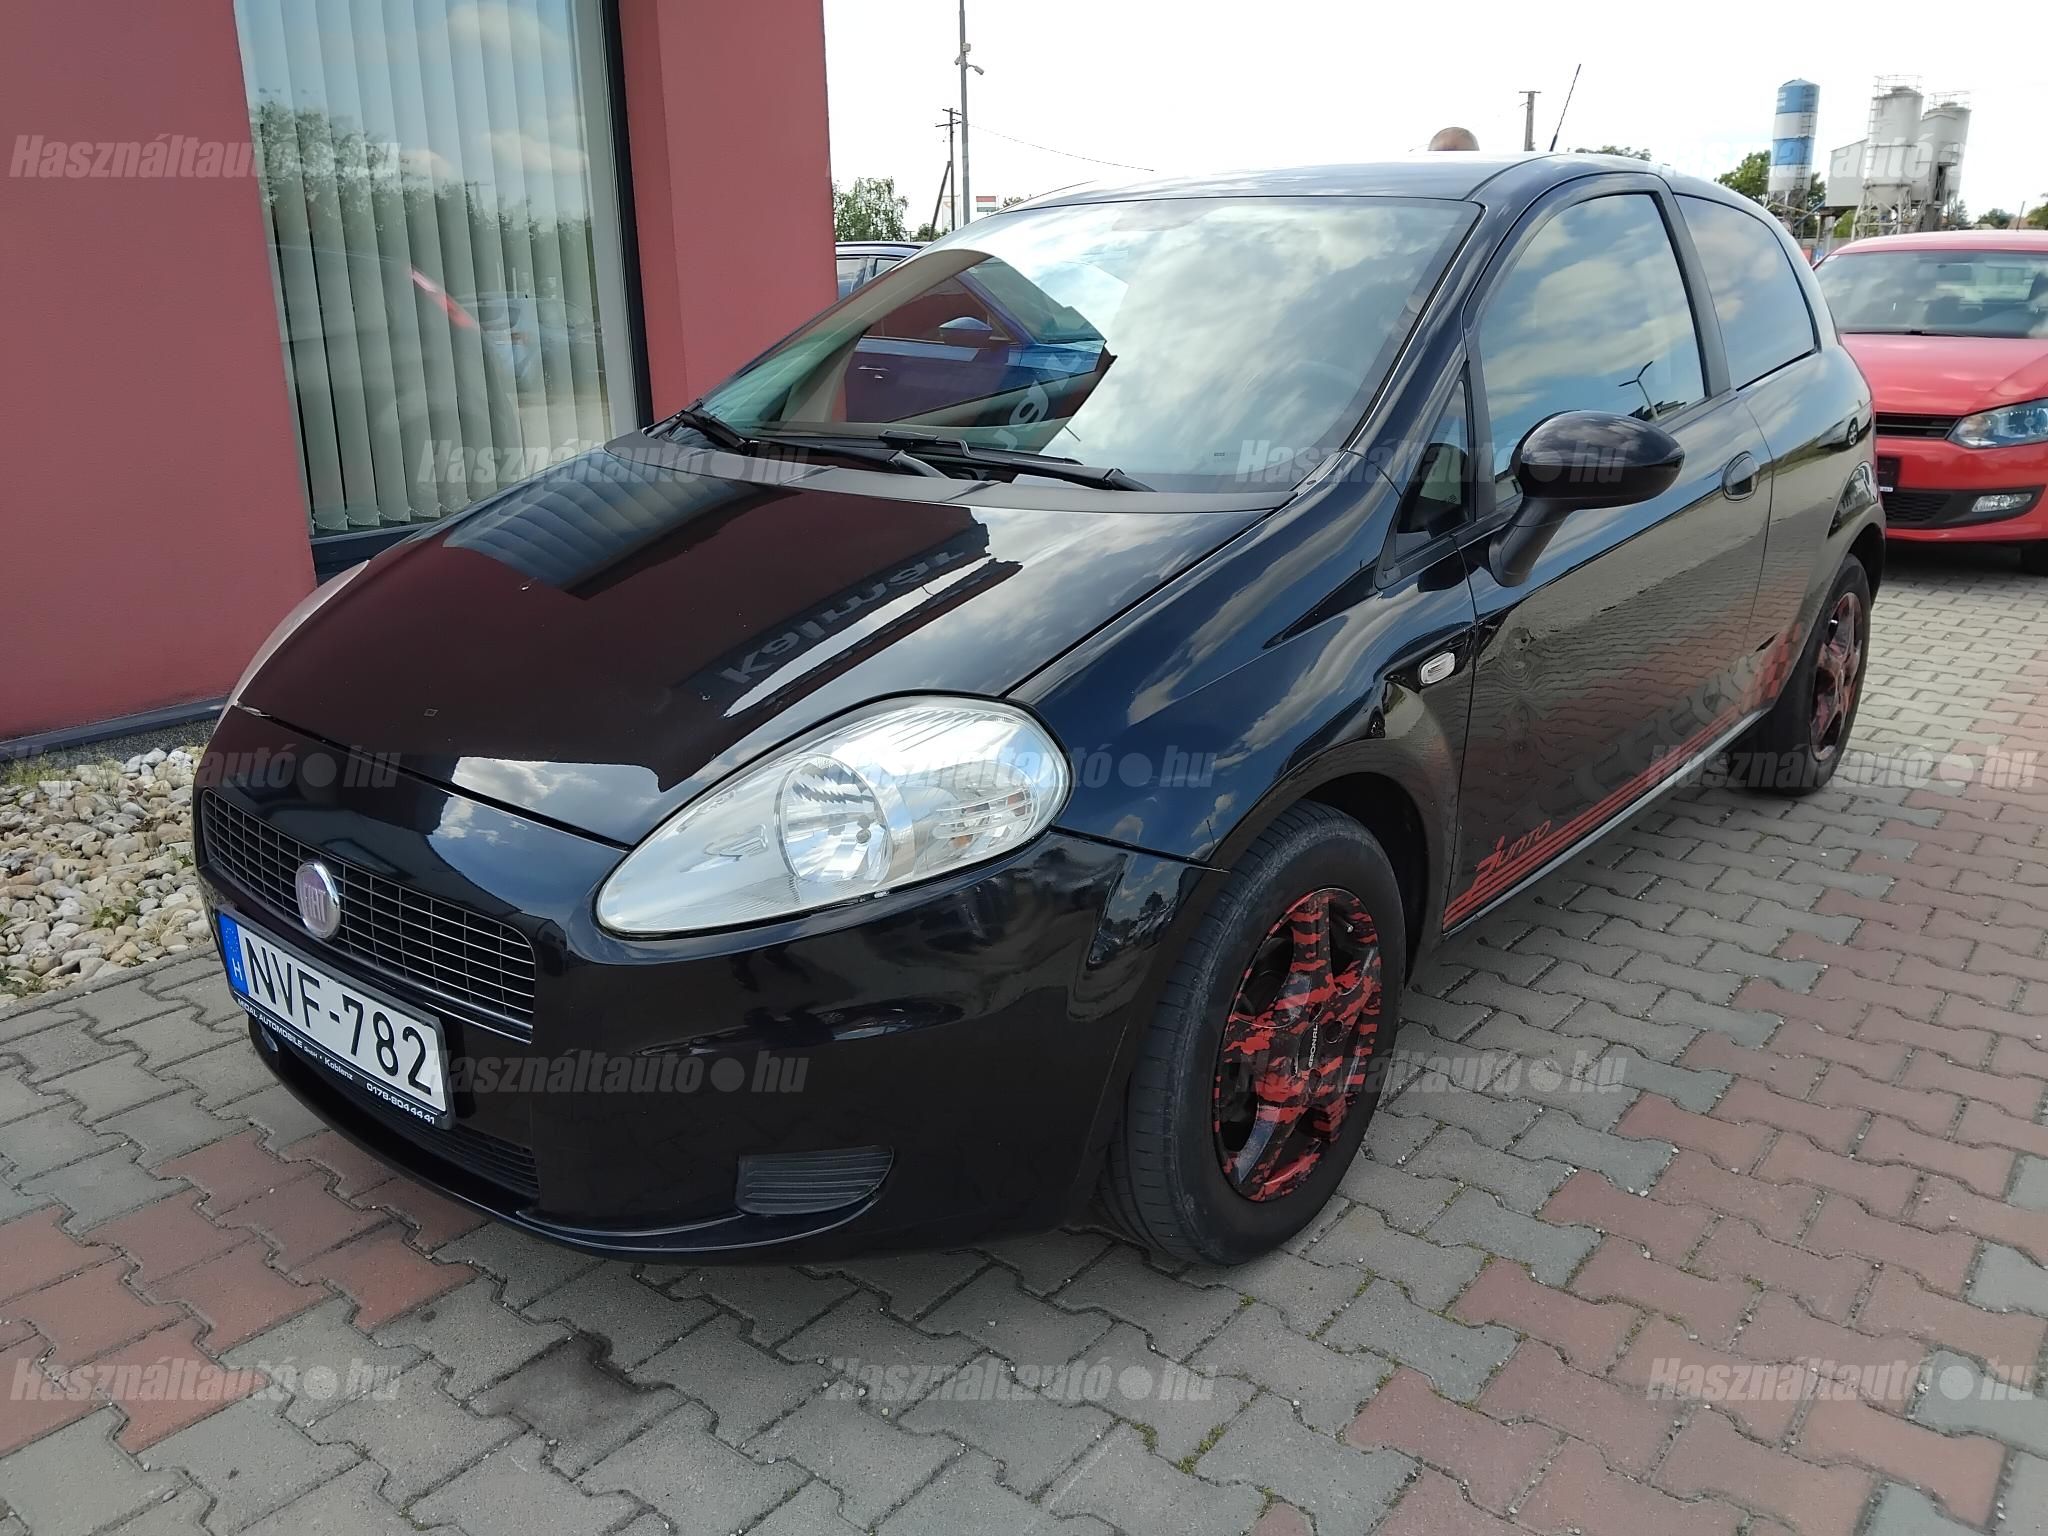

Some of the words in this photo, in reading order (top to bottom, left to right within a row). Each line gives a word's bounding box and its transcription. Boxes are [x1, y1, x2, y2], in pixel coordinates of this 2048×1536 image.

[232, 962, 243, 982] H
[245, 937, 432, 1097] NVF-782
[258, 1014, 303, 1049] AUTOMOBILE
[324, 1058, 354, 1081] Koblenz
